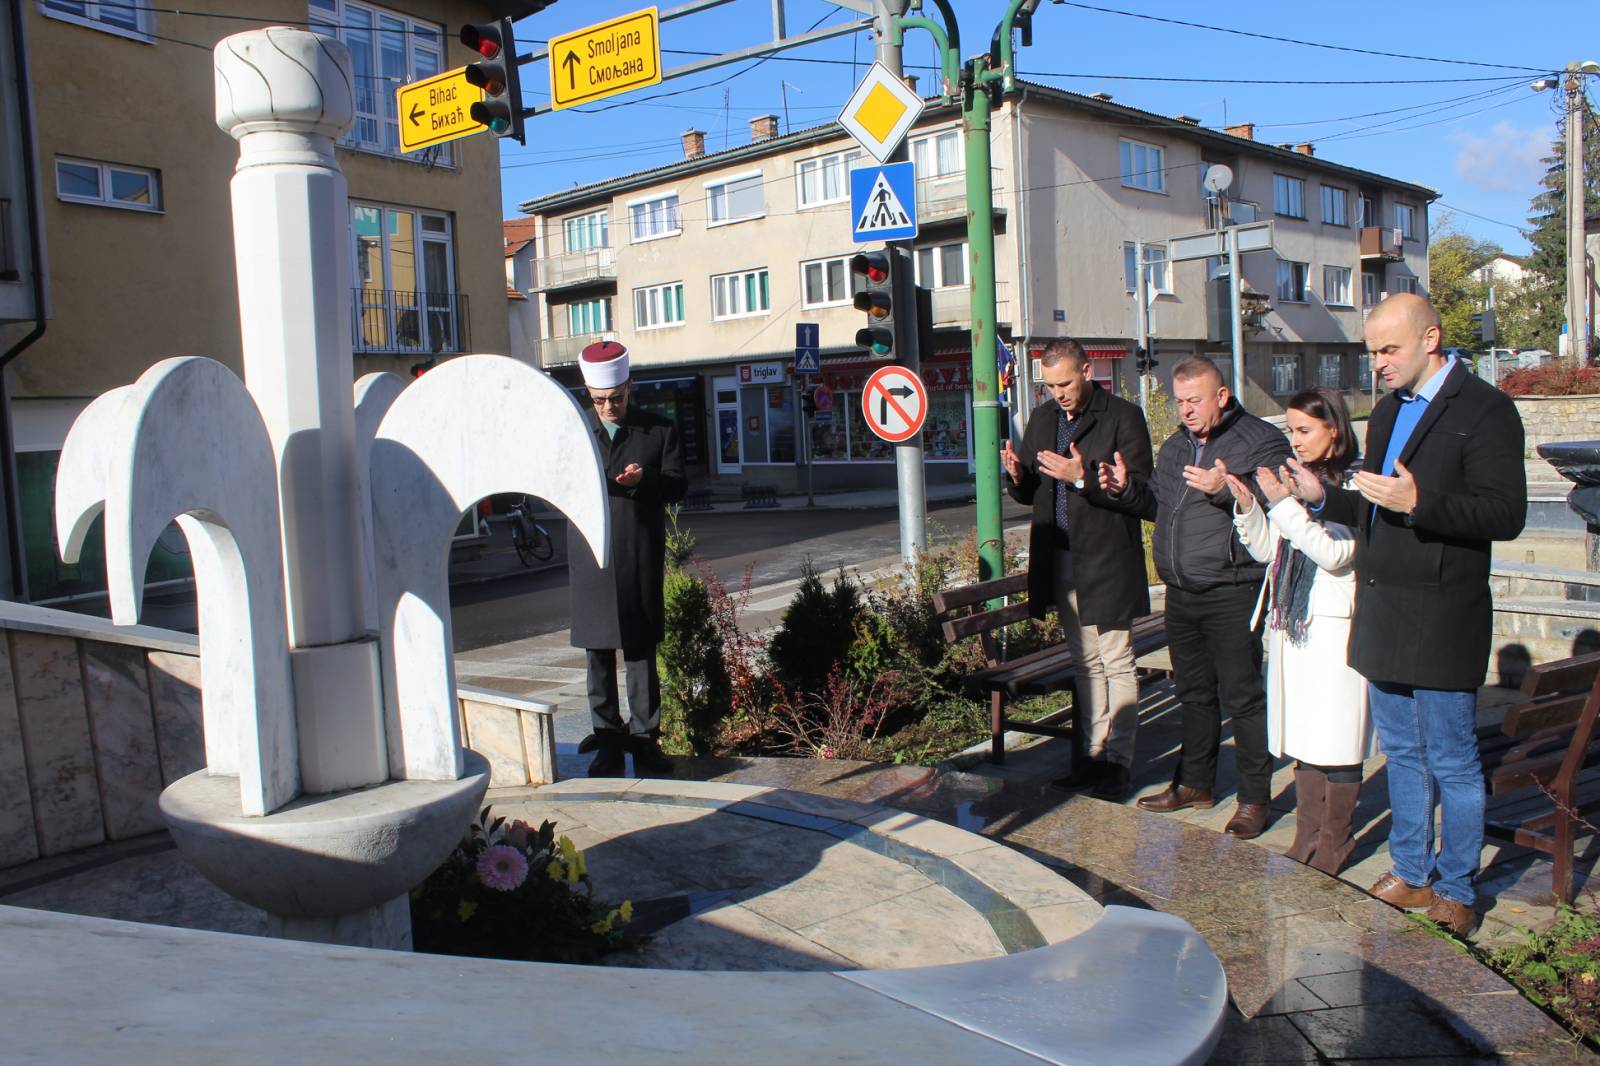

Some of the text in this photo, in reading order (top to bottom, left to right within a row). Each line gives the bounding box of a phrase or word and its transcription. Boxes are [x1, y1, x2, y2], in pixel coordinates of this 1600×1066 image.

[588, 30, 641, 59] Smoljana
[589, 57, 643, 85] Смољана
[429, 82, 457, 106] Bihać
[431, 106, 464, 130] Бихаћ
[753, 366, 777, 379] triglav
